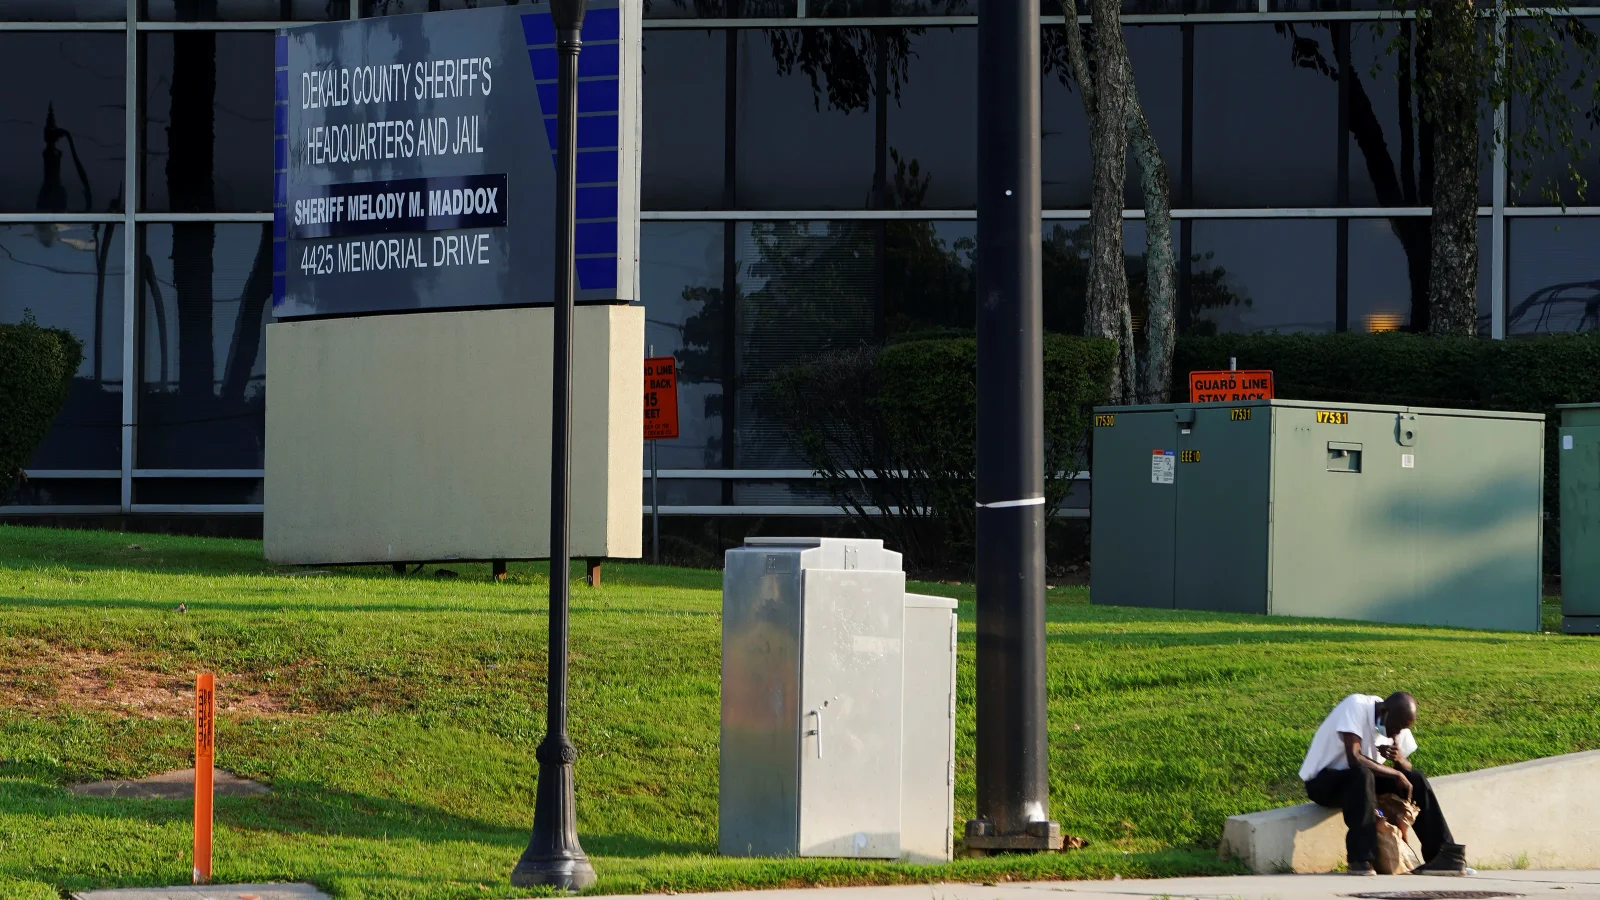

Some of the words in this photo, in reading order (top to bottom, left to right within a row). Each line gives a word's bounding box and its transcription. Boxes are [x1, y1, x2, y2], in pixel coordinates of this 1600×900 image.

[302, 68, 348, 109] DEKALB
[353, 63, 411, 104] COUNTY
[414, 57, 492, 100] SHERIFF'S
[307, 119, 414, 164] HEADQUARTERS
[417, 117, 448, 156] AND
[452, 115, 483, 154] JAIL
[294, 196, 344, 226] SHERIFF
[347, 192, 405, 221] MELODY
[408, 191, 425, 217] M.
[429, 187, 498, 216] MADDOX
[301, 244, 334, 276] 4425
[338, 238, 427, 273] MEMORIAL
[433, 233, 490, 267] DRIVE
[656, 365, 673, 375] LINE
[650, 379, 672, 388] BACK
[1195, 379, 1237, 390] GUARD
[1242, 379, 1268, 389] LINE
[1198, 393, 1227, 402] STAY
[1232, 393, 1265, 401] BACK
[644, 408, 660, 419] EET
[1230, 408, 1251, 421] V7531
[1316, 411, 1348, 424] V7531
[1095, 415, 1115, 427] V7530
